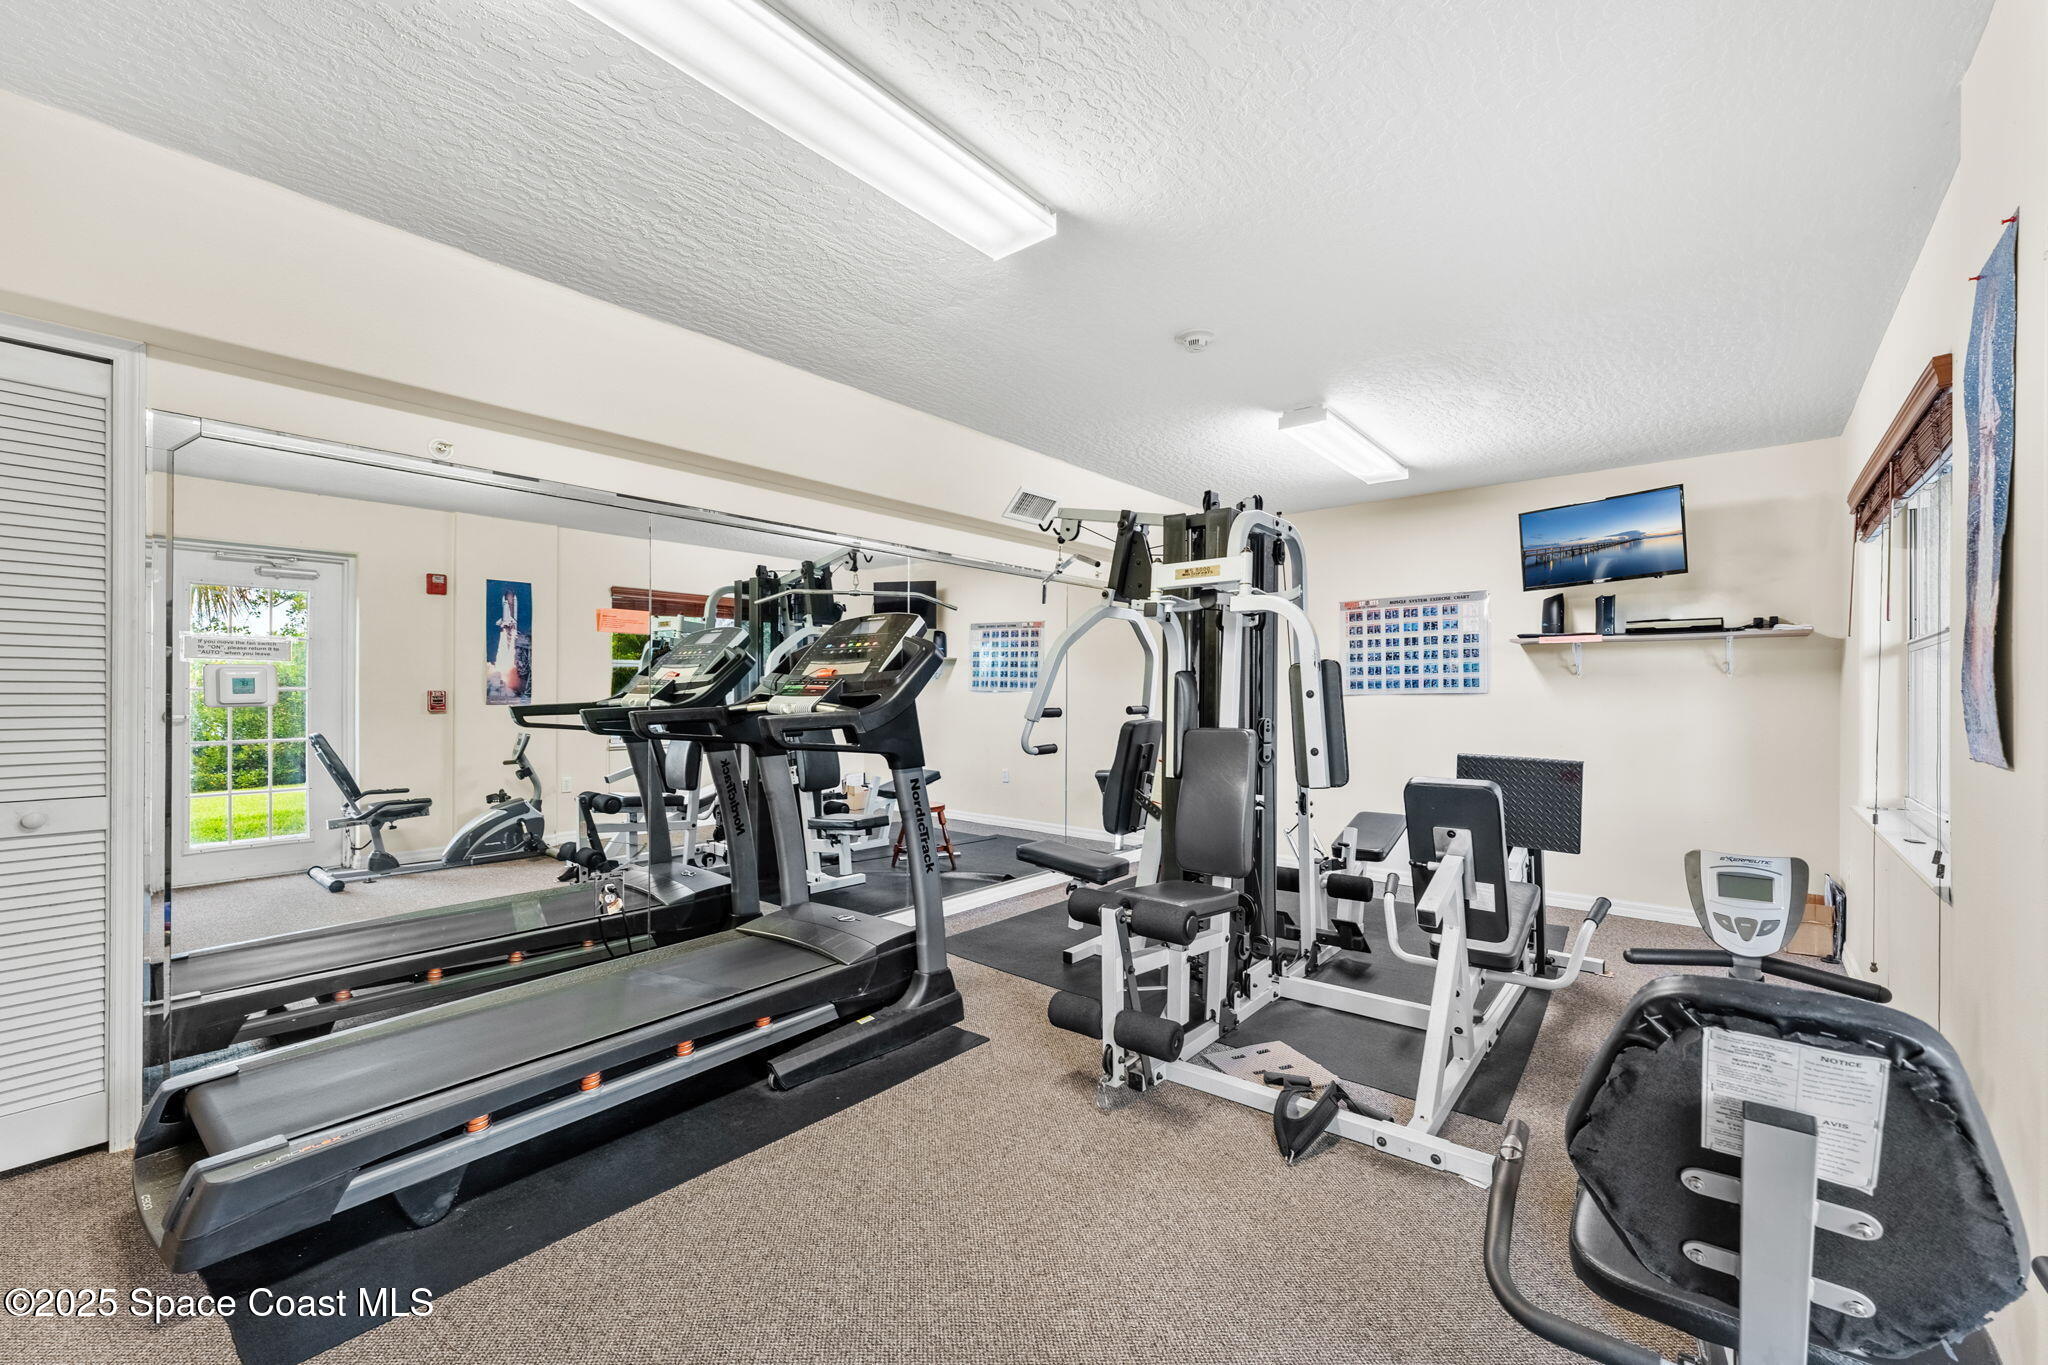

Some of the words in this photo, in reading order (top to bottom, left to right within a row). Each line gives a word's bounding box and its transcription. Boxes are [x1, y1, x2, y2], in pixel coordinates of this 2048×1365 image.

[910, 777, 936, 874] NordicTrack
[1820, 1056, 1863, 1068] NOTICE
[1823, 1120, 1849, 1129] AVIS
